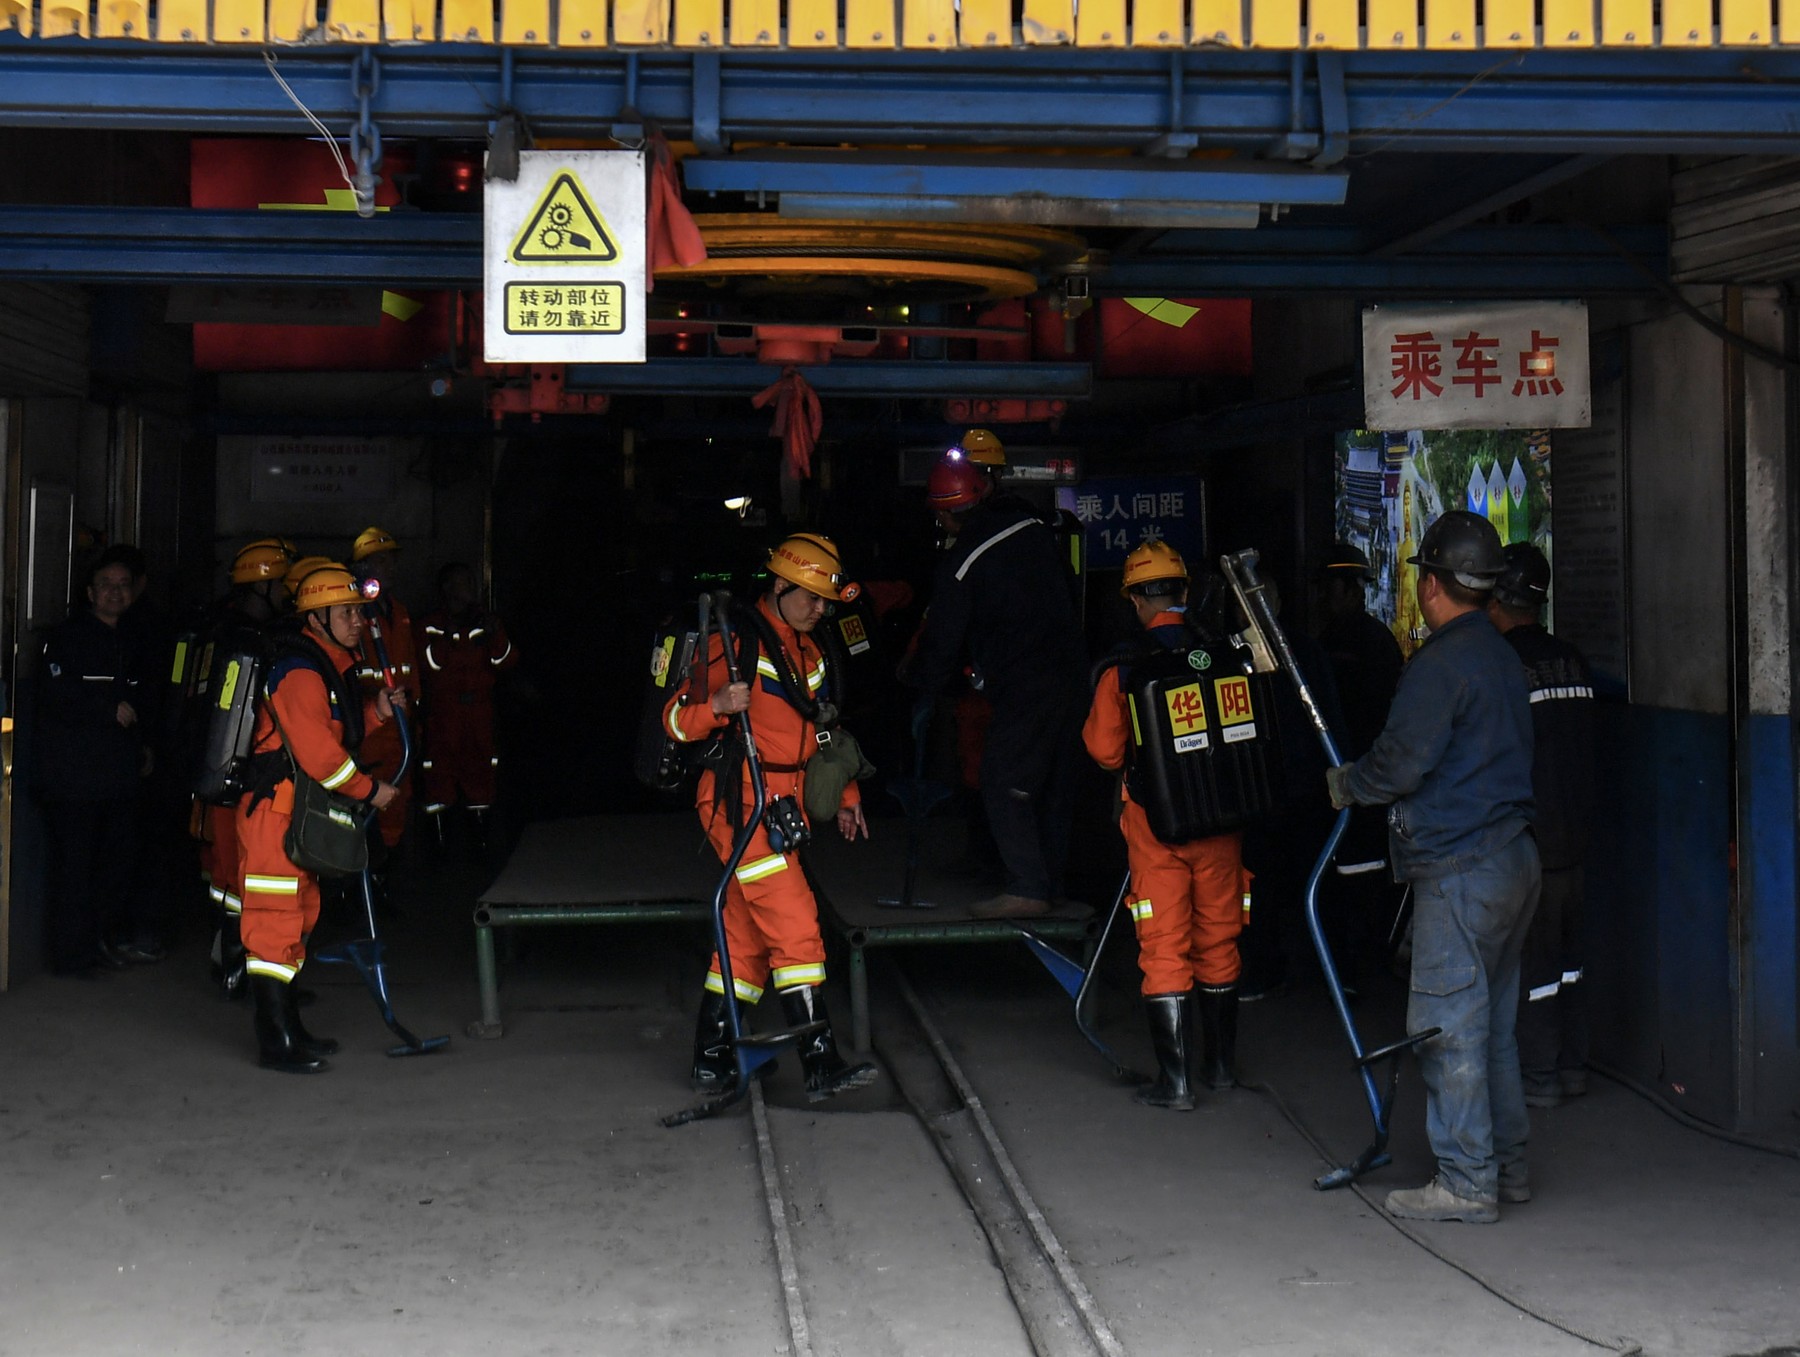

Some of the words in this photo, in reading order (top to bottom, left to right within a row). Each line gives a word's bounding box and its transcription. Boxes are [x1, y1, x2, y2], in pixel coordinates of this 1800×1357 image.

[519, 289, 611, 306] 转动部位
[519, 310, 611, 327] 请勿靠近
[1391, 330, 1564, 400] 乘车点
[1077, 492, 1184, 522] 乘人间距
[1100, 528, 1130, 550] 14
[1172, 681, 1250, 728] 华阳
[1180, 737, 1203, 749] Dräger
